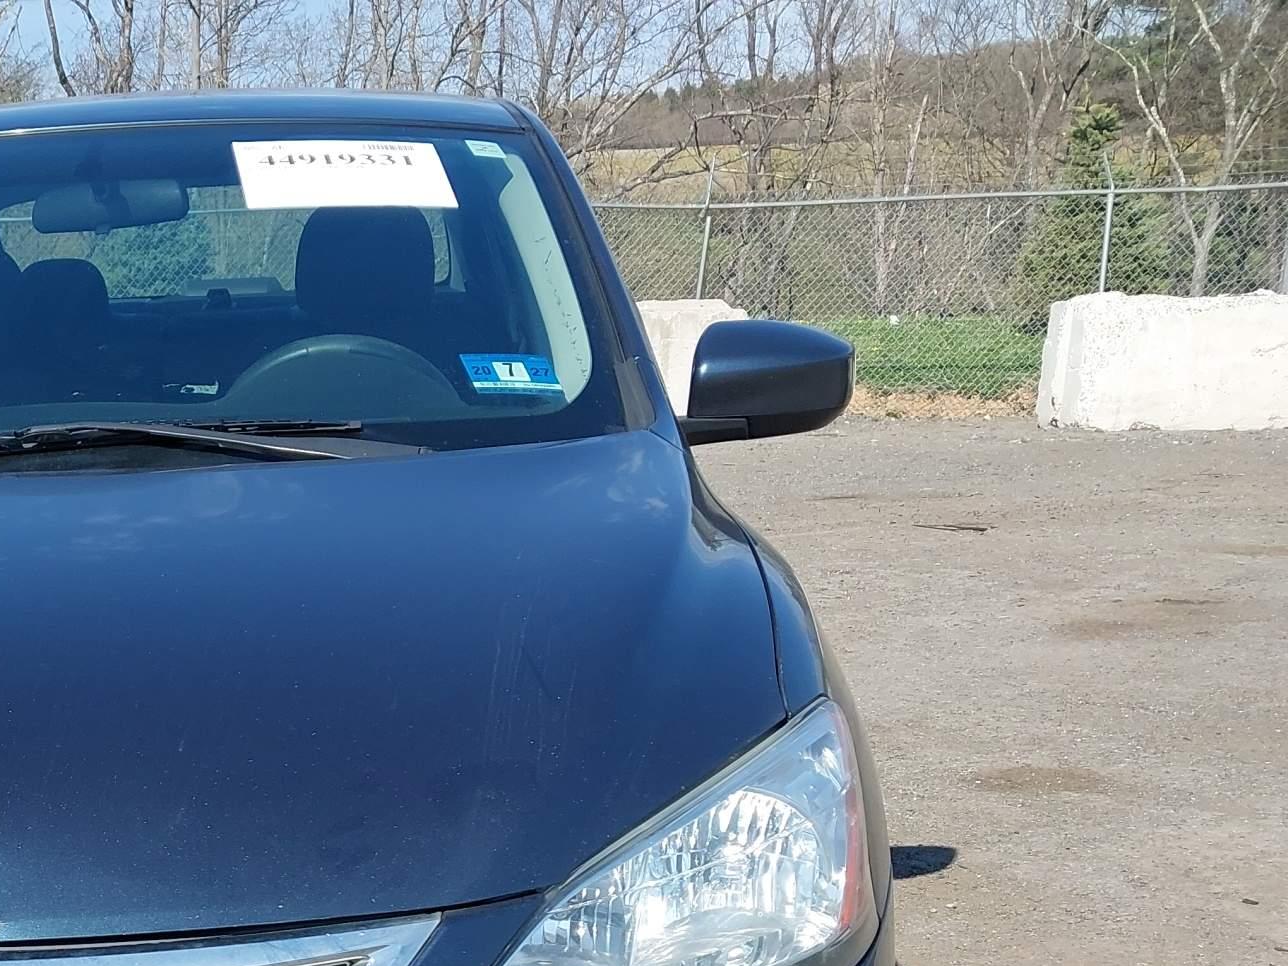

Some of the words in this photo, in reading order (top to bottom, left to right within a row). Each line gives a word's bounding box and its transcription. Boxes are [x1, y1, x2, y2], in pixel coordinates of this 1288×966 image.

[257, 152, 415, 167] 44919331
[472, 365, 492, 376] 20
[501, 362, 515, 377] 7
[530, 367, 550, 377] 27
